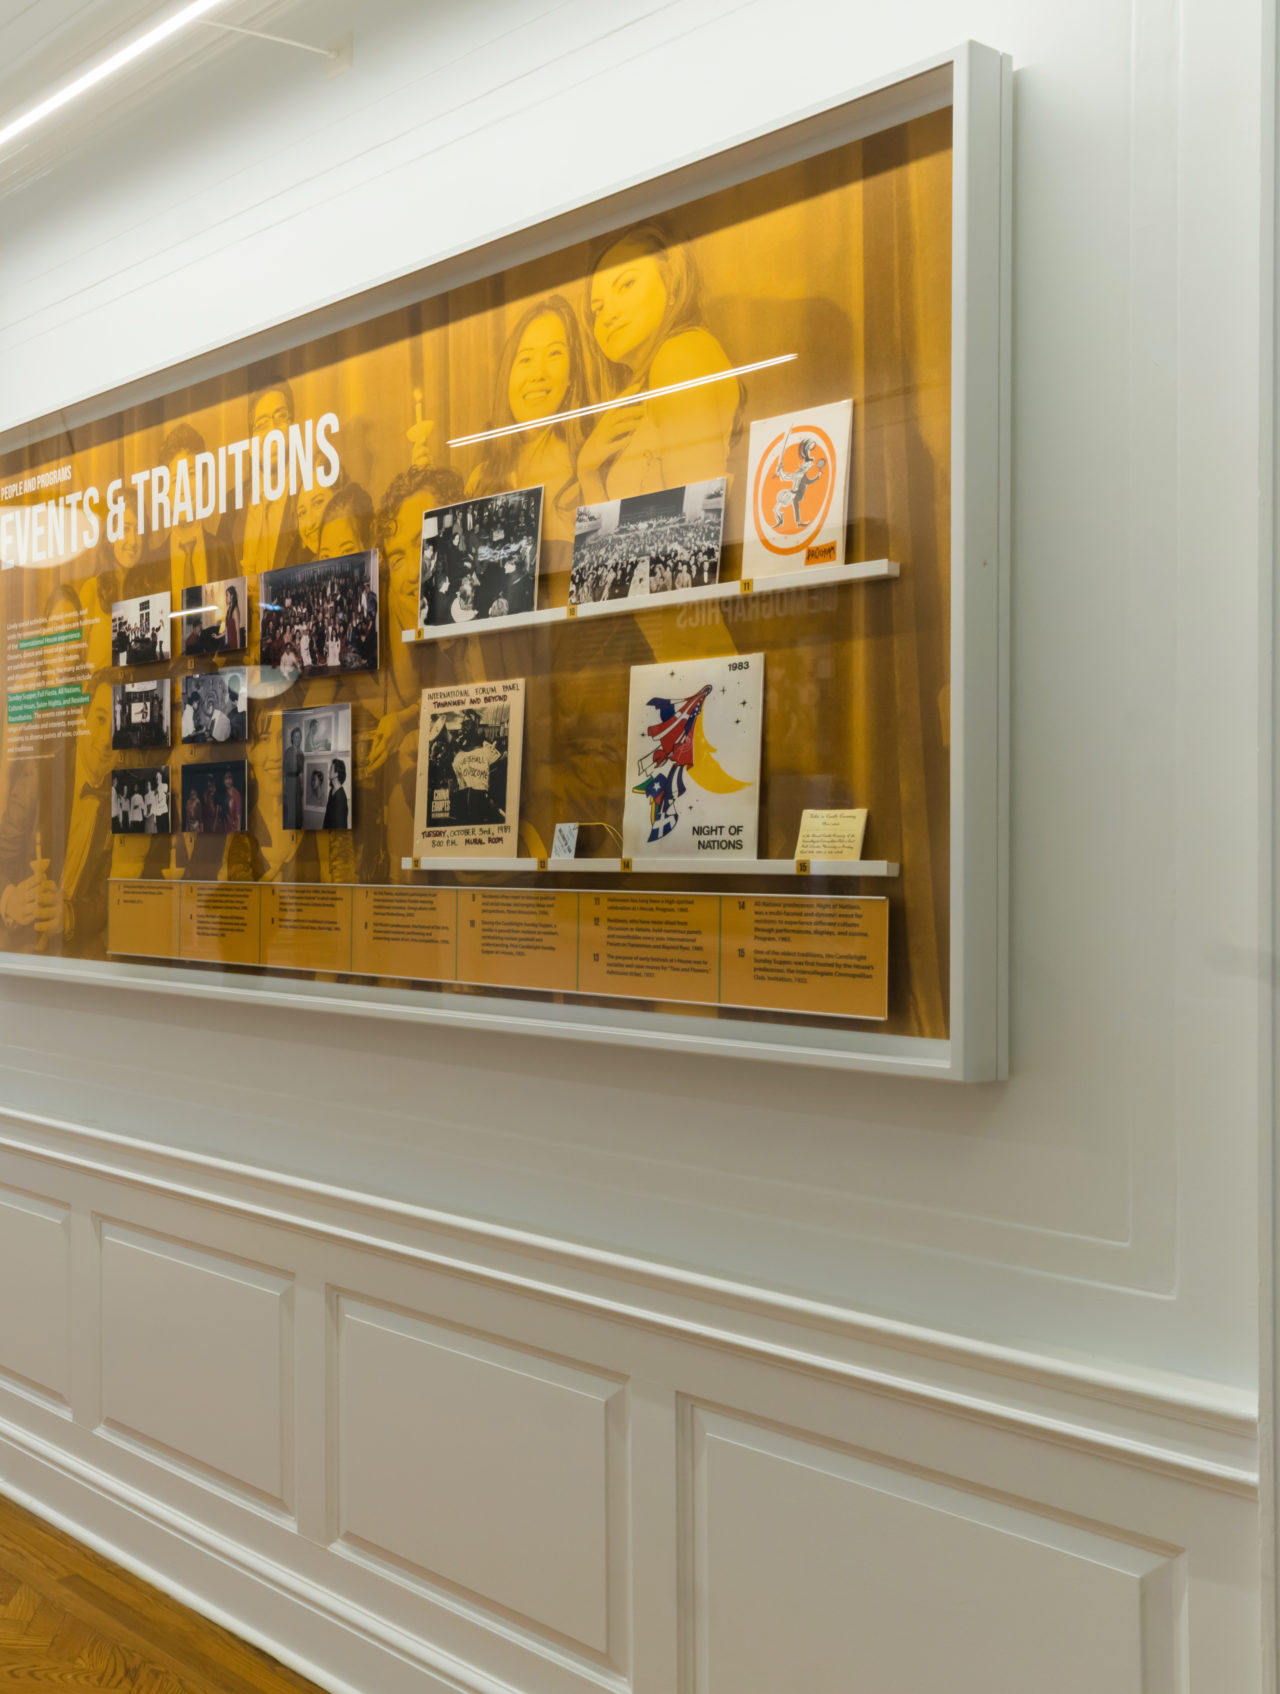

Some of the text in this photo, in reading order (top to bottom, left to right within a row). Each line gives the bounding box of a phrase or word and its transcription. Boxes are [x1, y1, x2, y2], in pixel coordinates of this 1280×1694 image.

[0, 465, 72, 501] PEOPLE AND PROGRAMS
[1, 412, 340, 571] EVENTS & TRADITIONS
[743, 582, 750, 591] 11
[569, 606, 576, 617] 10
[727, 661, 750, 671] 1983
[427, 683, 520, 701] INTERNATIONAL FORUM PANEL
[484, 694, 507, 704] BEYOND
[450, 828, 476, 836] OCTOBER
[692, 825, 743, 837] NIGHT OF
[464, 837, 485, 845] MURAL
[697, 839, 743, 850] NATIONS
[623, 861, 629, 869] 14
[799, 862, 807, 872] 15
[738, 900, 745, 910] 14
[738, 948, 745, 957] 15
